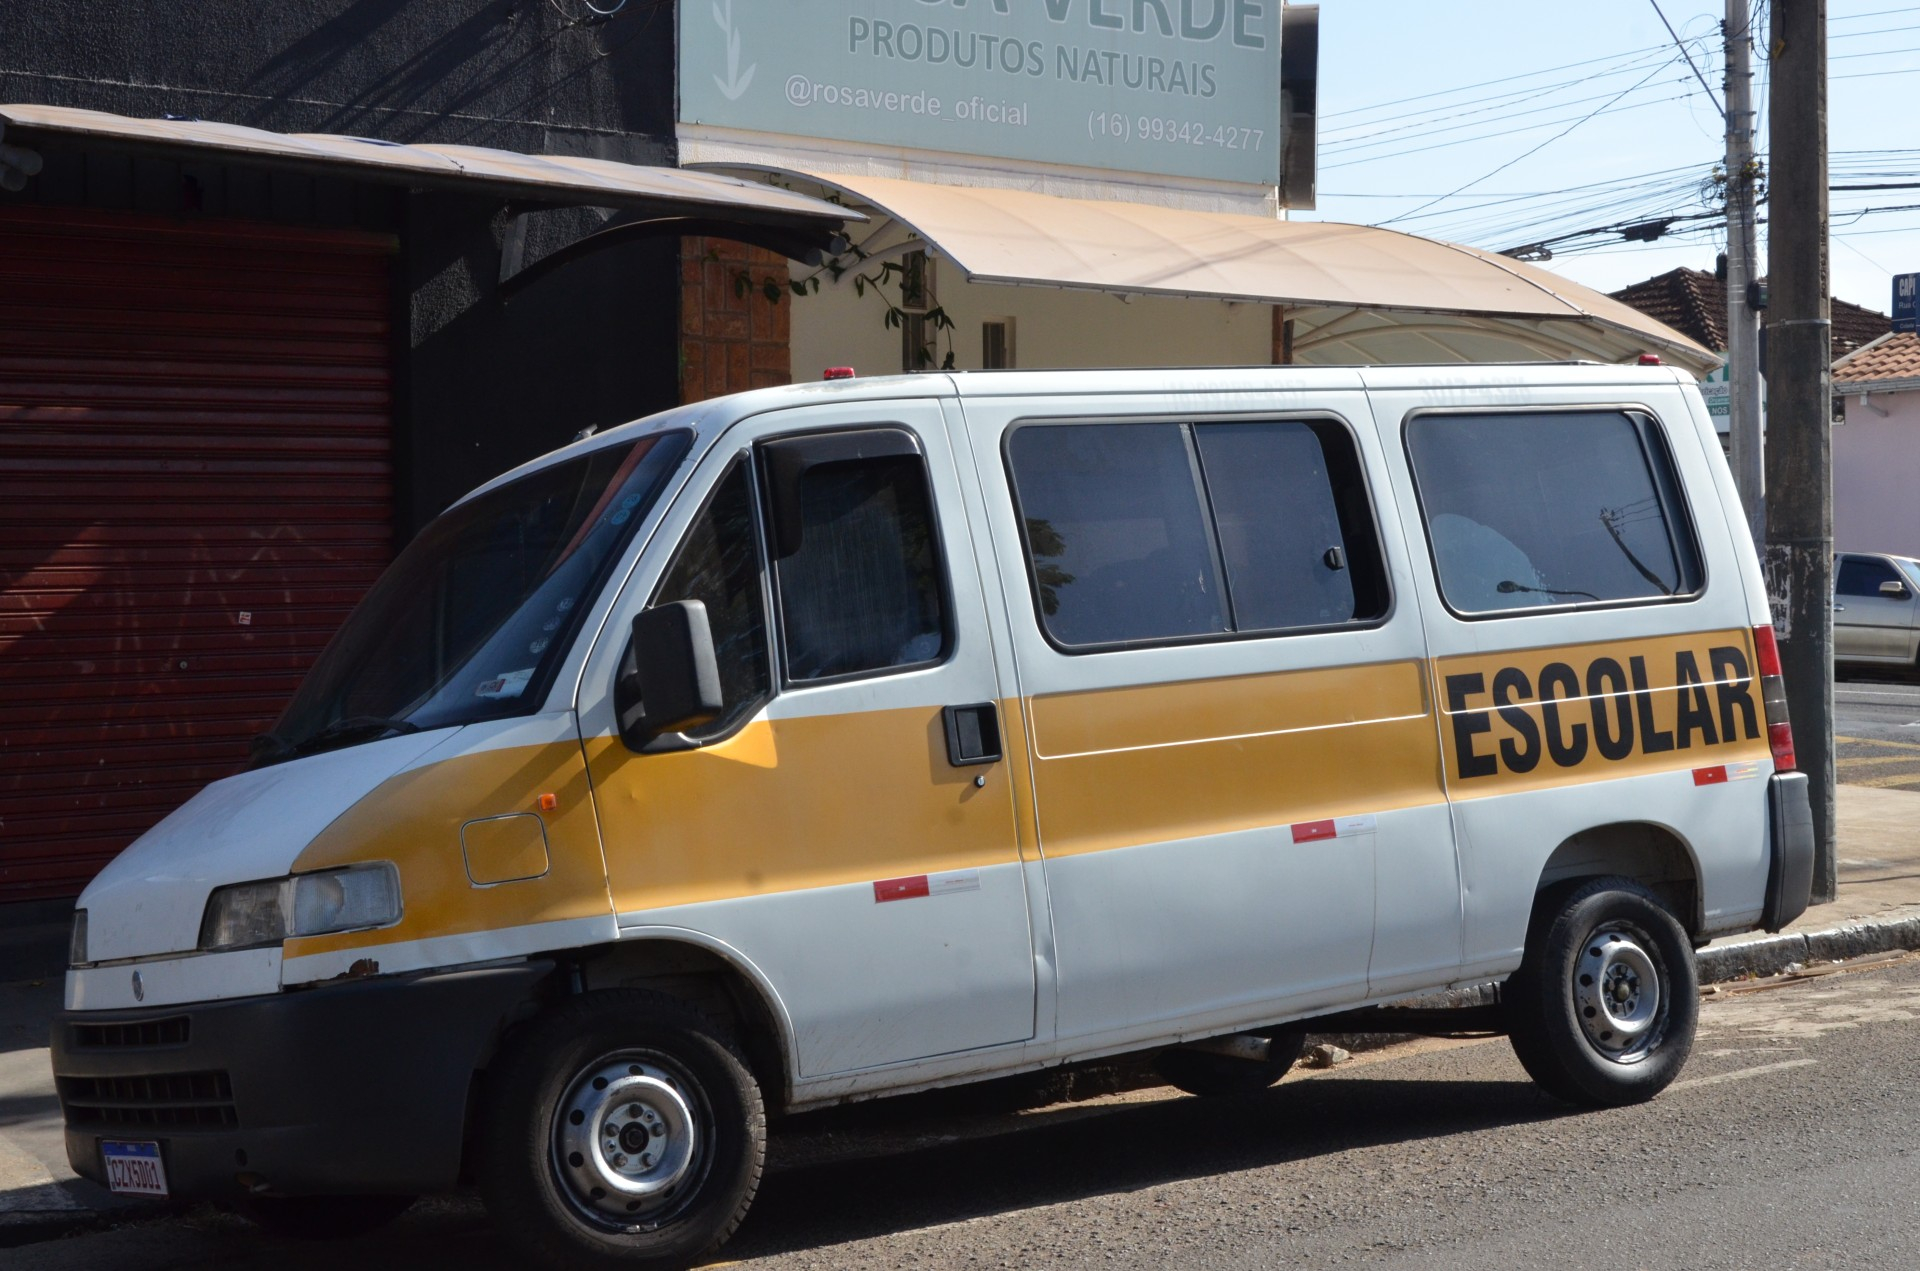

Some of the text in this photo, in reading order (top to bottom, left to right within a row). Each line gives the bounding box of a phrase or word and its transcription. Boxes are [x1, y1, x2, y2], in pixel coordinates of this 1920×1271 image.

[849, 16, 1217, 99] PRODUTOS NATURAIS
[785, 74, 1028, 126] @rosaverde_oficial
[1088, 110, 1265, 151] (16) 99342-4277
[1445, 646, 1761, 780] ESCOLAR
